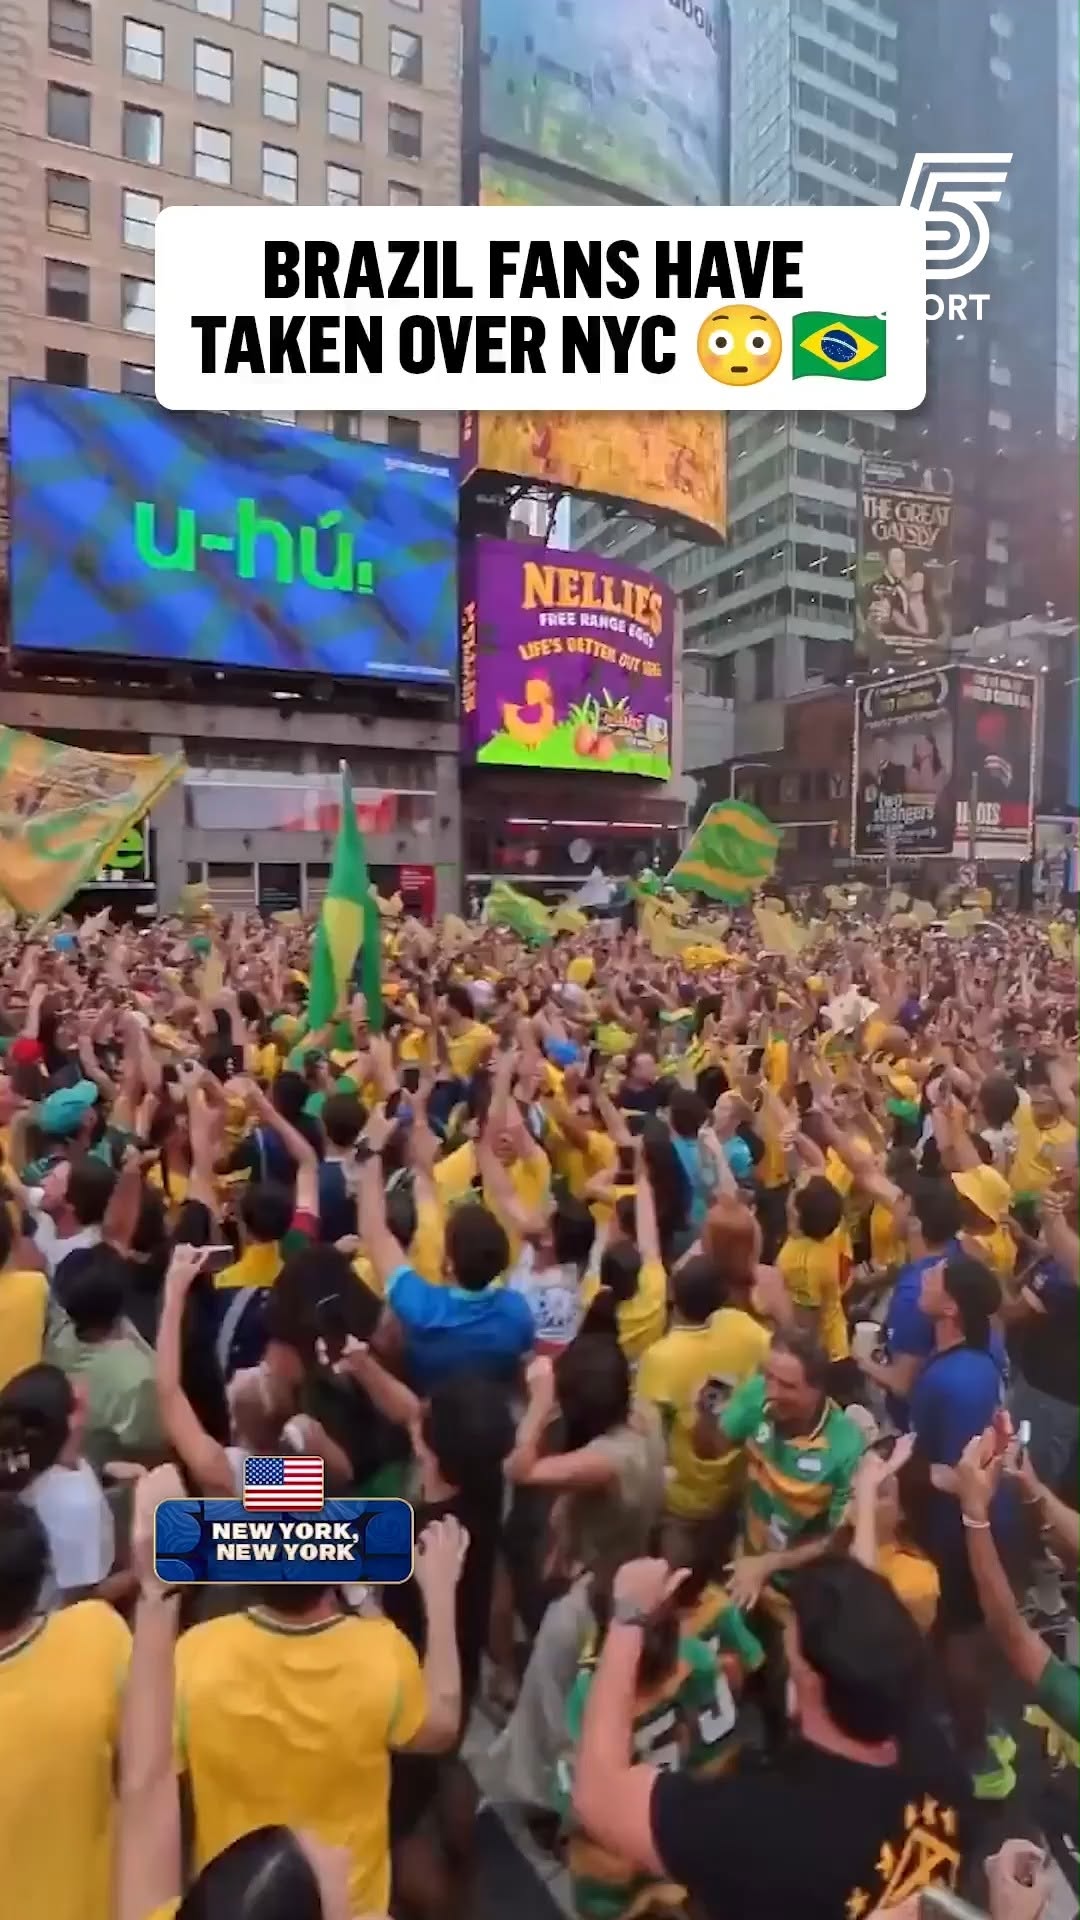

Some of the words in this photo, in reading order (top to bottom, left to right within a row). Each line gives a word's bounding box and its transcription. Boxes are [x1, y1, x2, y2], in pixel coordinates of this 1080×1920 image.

[863, 495, 893, 520] THE
[895, 501, 951, 528] GREAT
[135, 497, 374, 595] u-hú!
[872, 520, 940, 546] GATSBY
[522, 561, 663, 637] NELLIE'S
[539, 612, 577, 627] FREE
[580, 613, 626, 634] RANGE
[518, 637, 563, 661] LIFE'S
[619, 652, 641, 672] OUT
